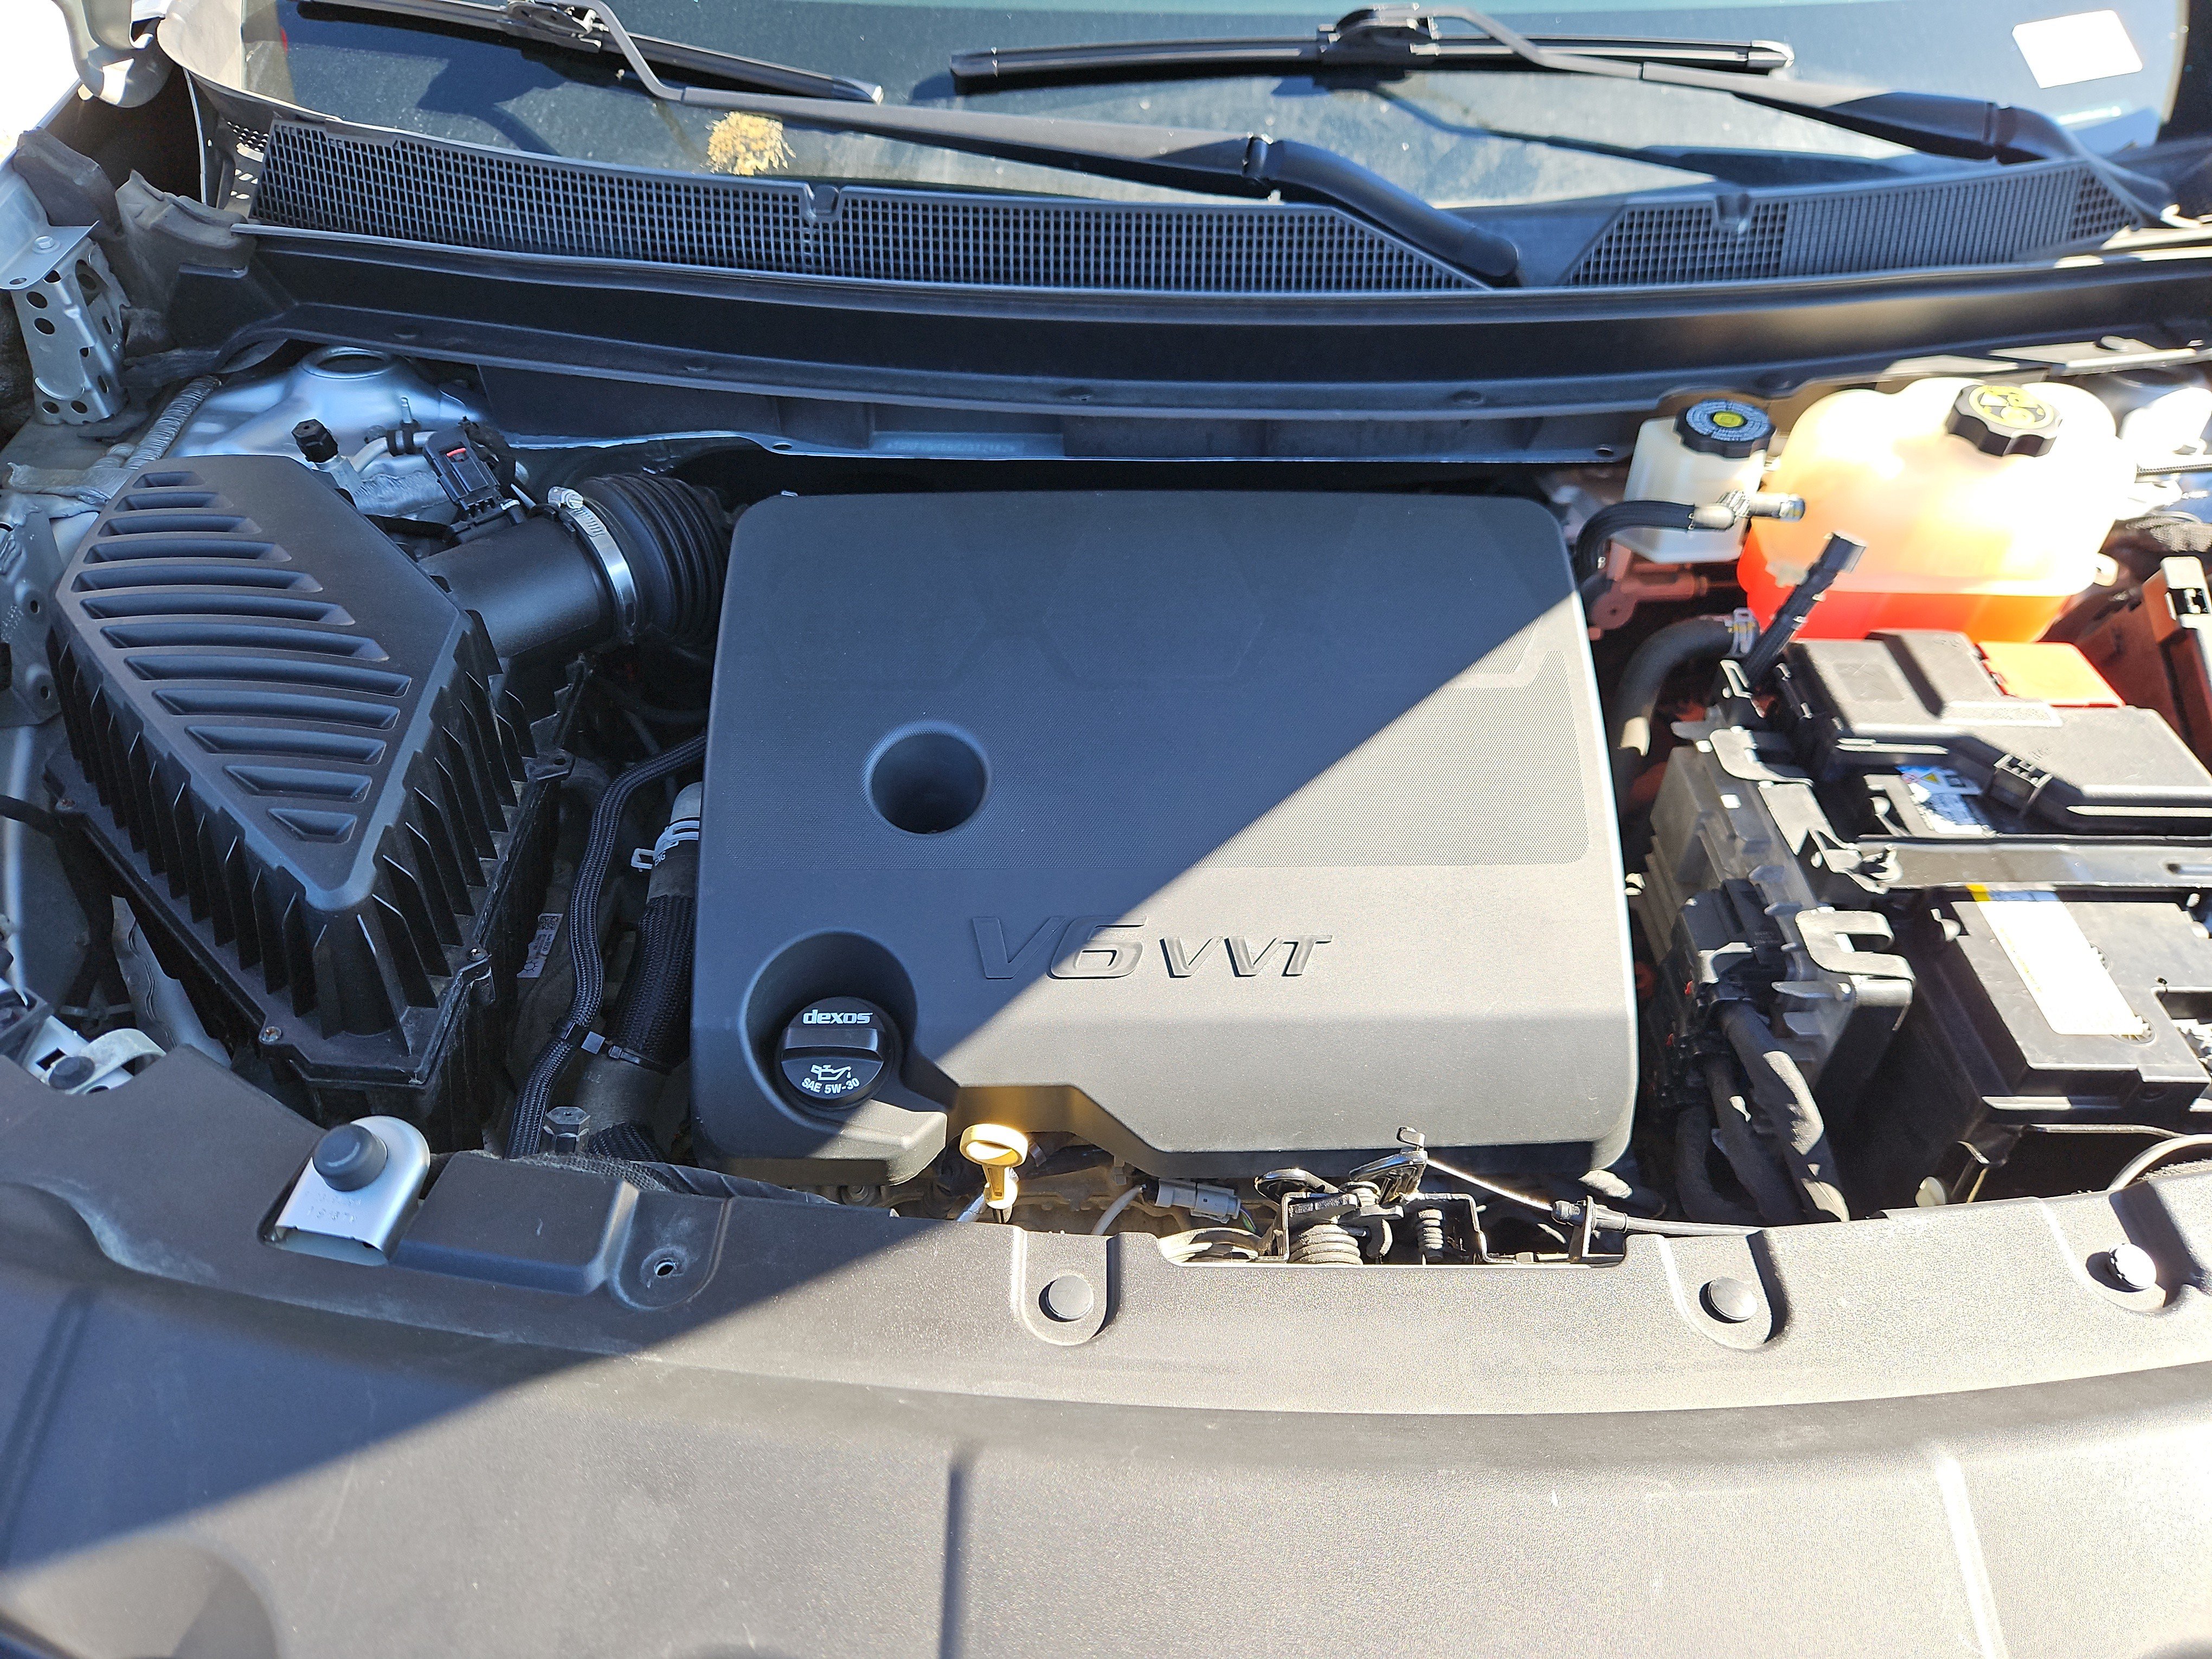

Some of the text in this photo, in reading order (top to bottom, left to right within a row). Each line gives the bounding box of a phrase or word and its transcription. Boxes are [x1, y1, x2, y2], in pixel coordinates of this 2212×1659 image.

[973, 916, 1333, 979] V6 VVT
[802, 1009, 873, 1024] dexos
[801, 1077, 860, 1094] SAE 5W-30
